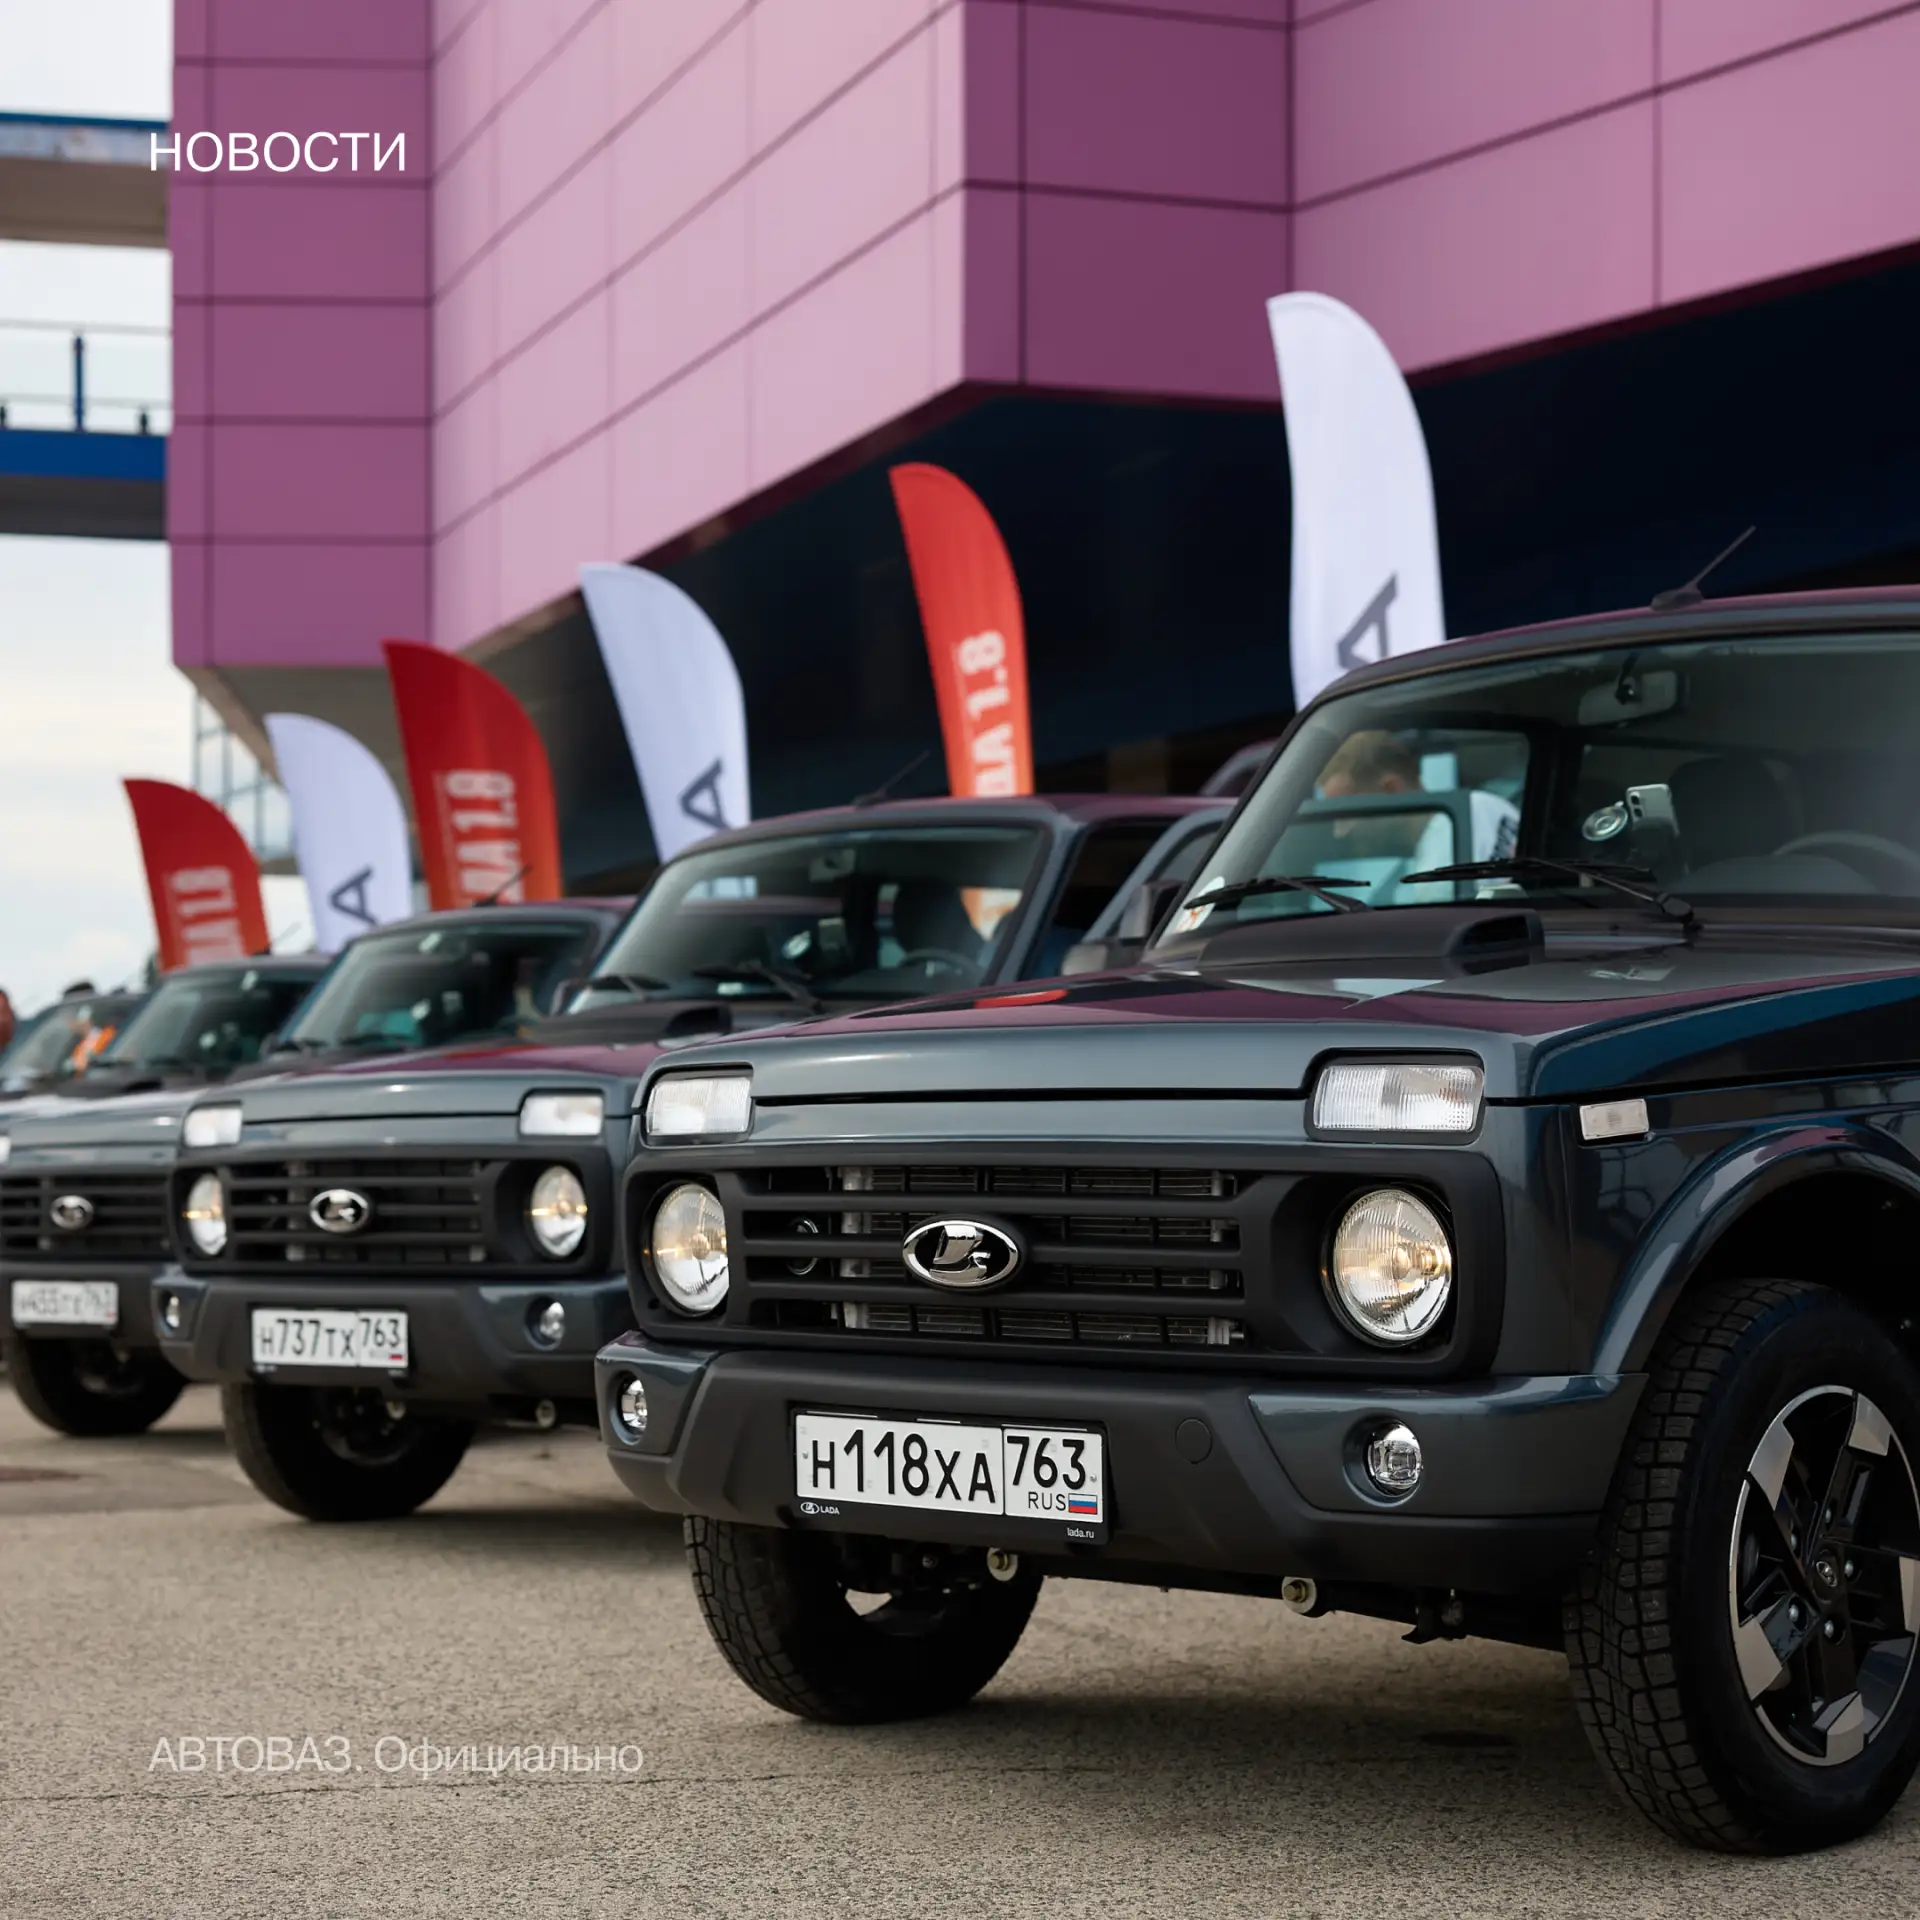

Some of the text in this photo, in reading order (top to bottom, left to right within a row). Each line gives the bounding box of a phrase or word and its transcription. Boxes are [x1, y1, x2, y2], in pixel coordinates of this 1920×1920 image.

[957, 629, 1011, 720] 1.8
[446, 769, 518, 833] 1.8
[261, 1318, 400, 1358] Н737ТХ 763
[812, 1429, 1086, 1503] Н118ХА 763
[820, 1505, 840, 1515] LADA
[1028, 1491, 1066, 1511] RUS
[1067, 1527, 1094, 1538] lada.ru
